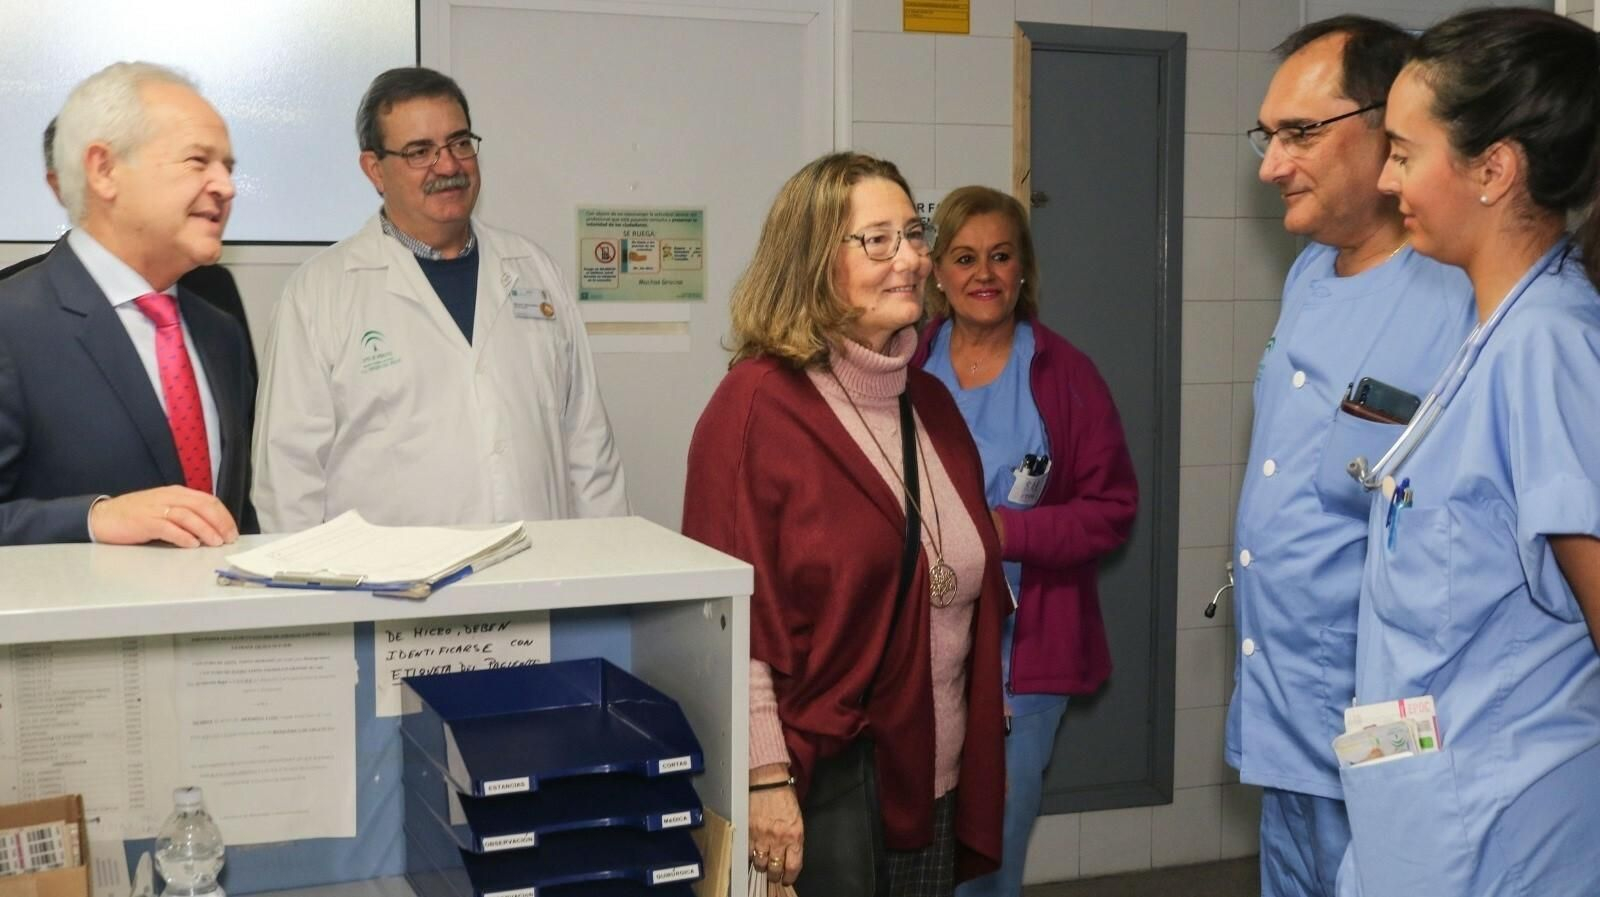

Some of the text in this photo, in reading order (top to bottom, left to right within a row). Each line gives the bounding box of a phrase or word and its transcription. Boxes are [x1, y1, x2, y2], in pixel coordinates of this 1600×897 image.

[385, 630, 403, 643] DE
[463, 620, 512, 634] DEBEN
[385, 639, 534, 661] IDENTIFICARSE CON
[488, 782, 526, 790] ESTANCIAS
